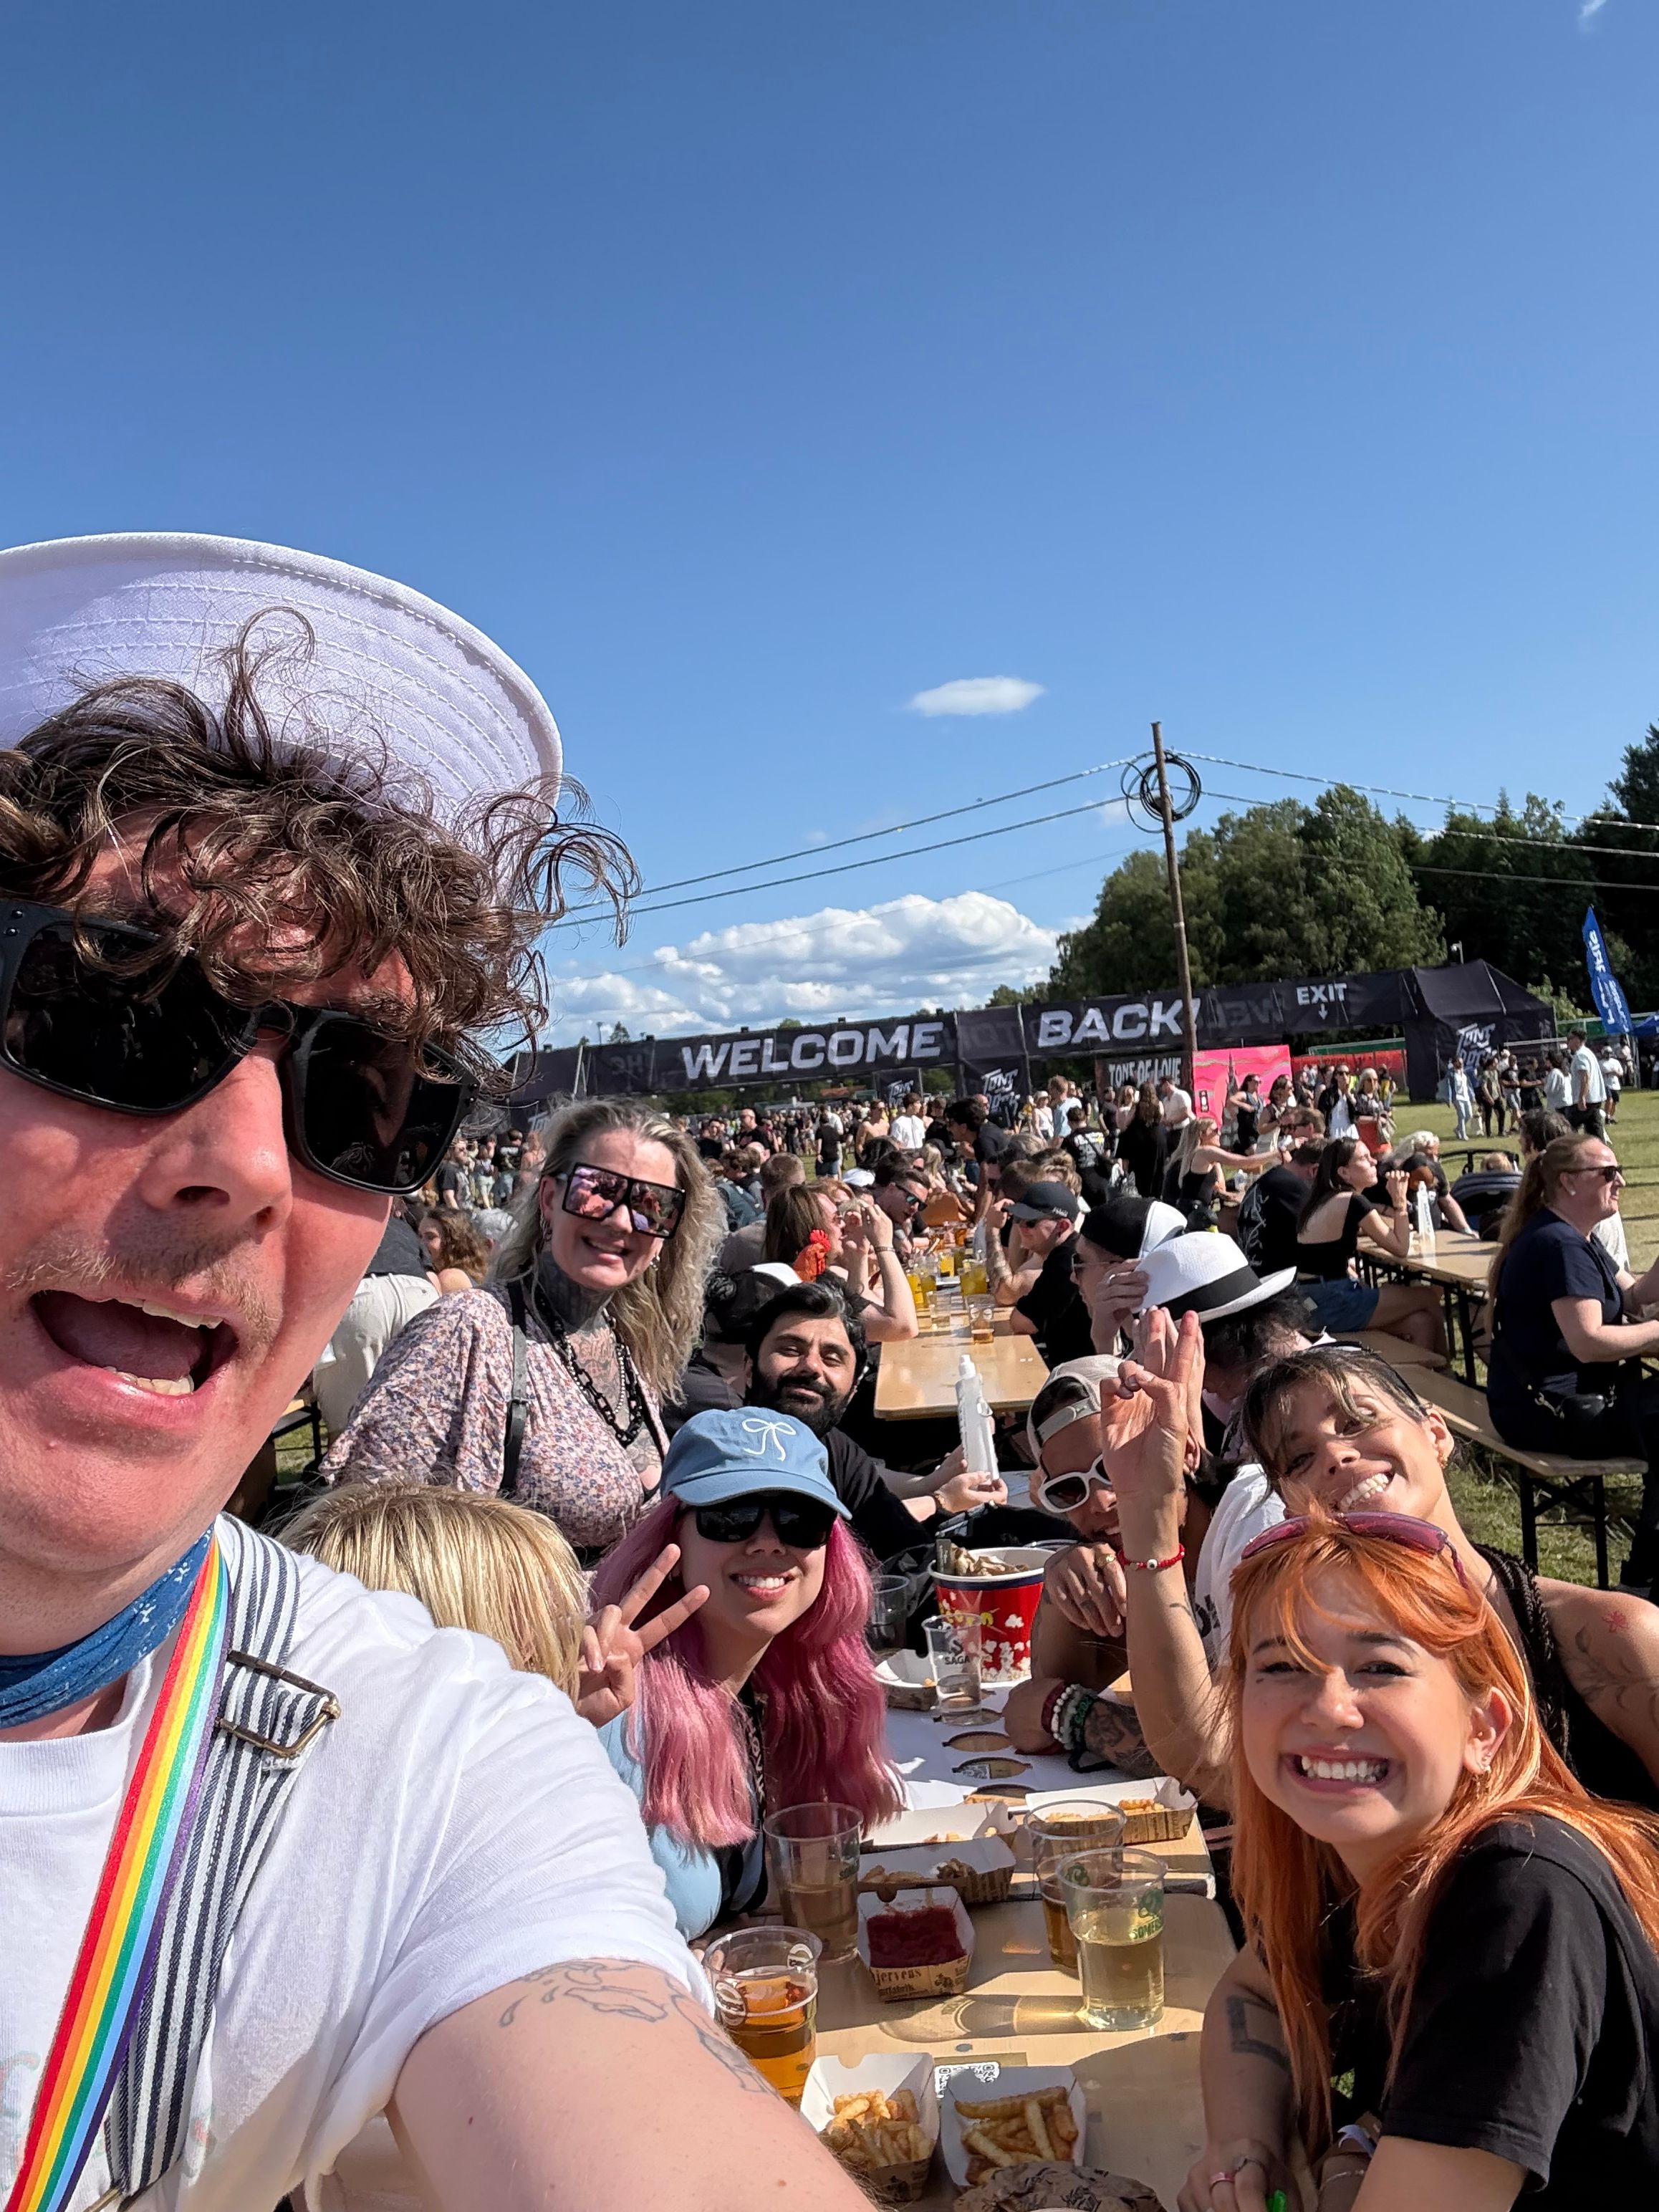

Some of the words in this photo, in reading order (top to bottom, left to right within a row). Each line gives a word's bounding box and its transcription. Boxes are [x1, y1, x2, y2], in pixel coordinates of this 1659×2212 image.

[1297, 982, 1347, 1006] EXIT
[681, 1021, 944, 1079] WELCOME
[944, 1655, 971, 1665] SAGA
